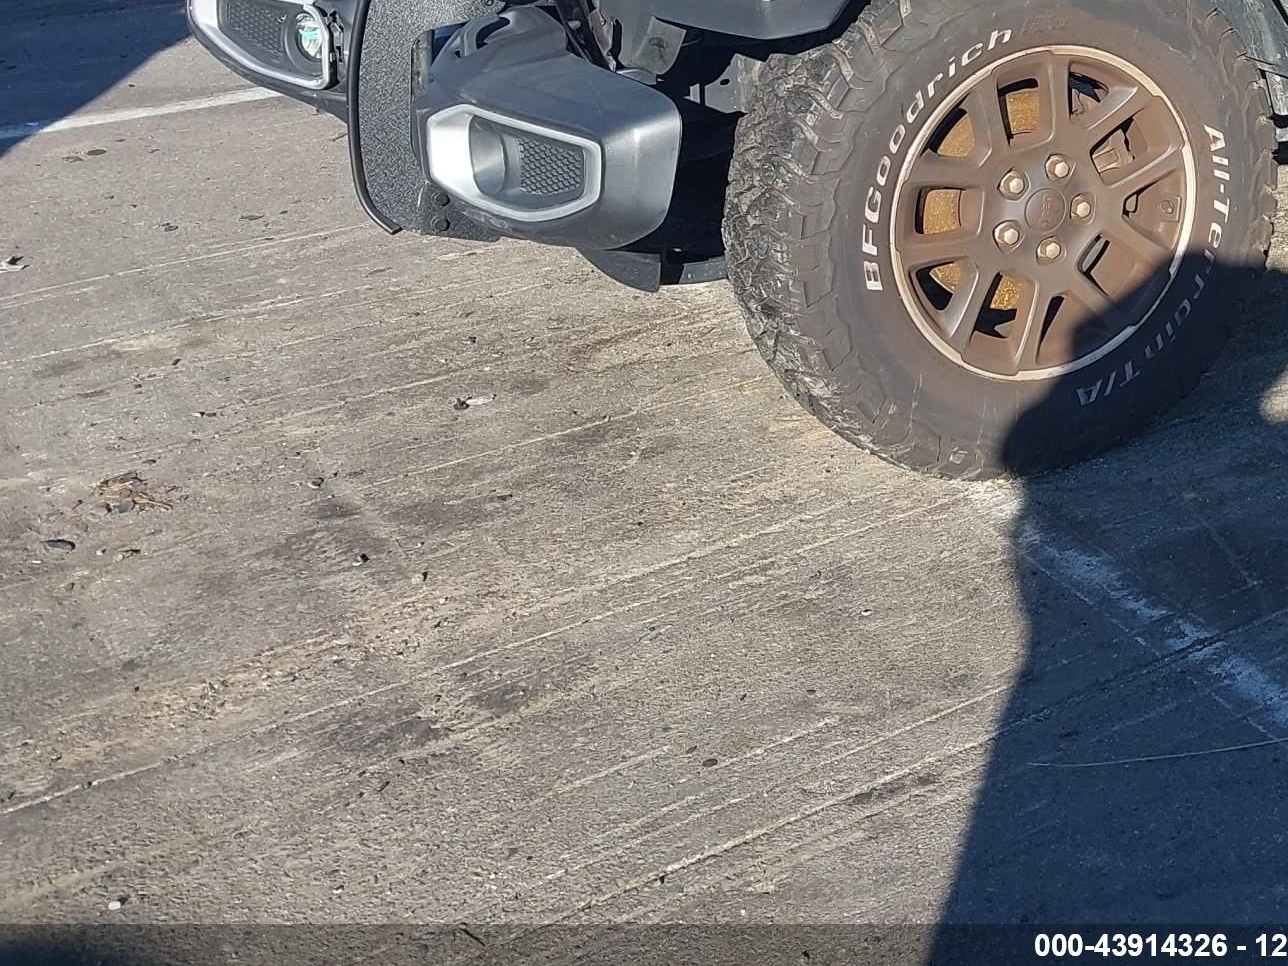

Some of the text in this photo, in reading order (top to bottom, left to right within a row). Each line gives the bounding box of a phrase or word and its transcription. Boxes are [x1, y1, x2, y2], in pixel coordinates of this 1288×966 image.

[861, 28, 1013, 292] BFGoodrich
[1075, 124, 1231, 406] All-Terrain T/A
